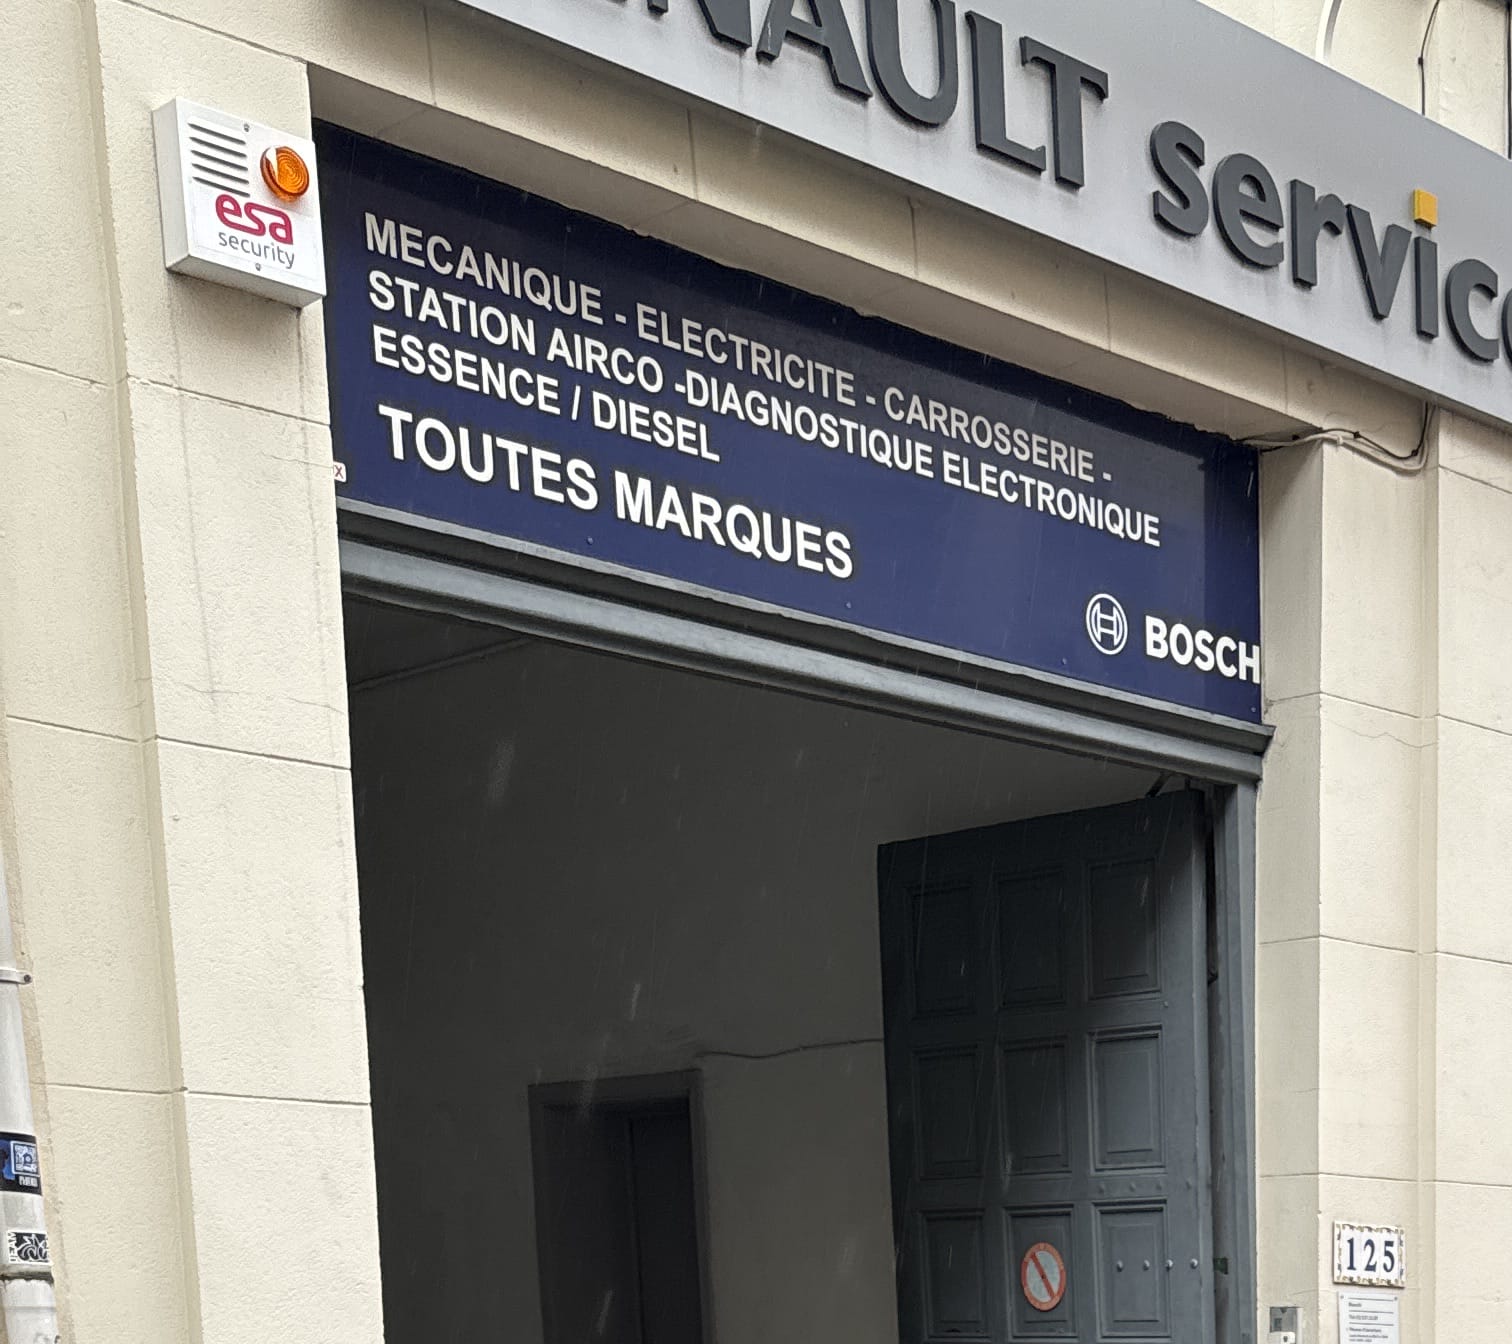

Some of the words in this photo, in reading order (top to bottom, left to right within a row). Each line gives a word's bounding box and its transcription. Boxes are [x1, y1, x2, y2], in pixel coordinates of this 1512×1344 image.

[215, 194, 294, 245] esa
[218, 231, 295, 270] security
[364, 212, 604, 325] MECANIQUE
[636, 302, 856, 407] ELECTRICITE
[884, 386, 1095, 484] CARROSSERIE
[372, 324, 561, 415] ESSENCE
[591, 391, 721, 462] DIESEL
[368, 270, 536, 356] STATION
[546, 327, 664, 393] AIRCO
[943, 451, 1161, 548] ELECTRONIQUE
[377, 404, 598, 511] TOUTES
[614, 470, 853, 579] MARQUES
[1144, 615, 1261, 685] BOSCH
[1345, 1236, 1395, 1273] 125
